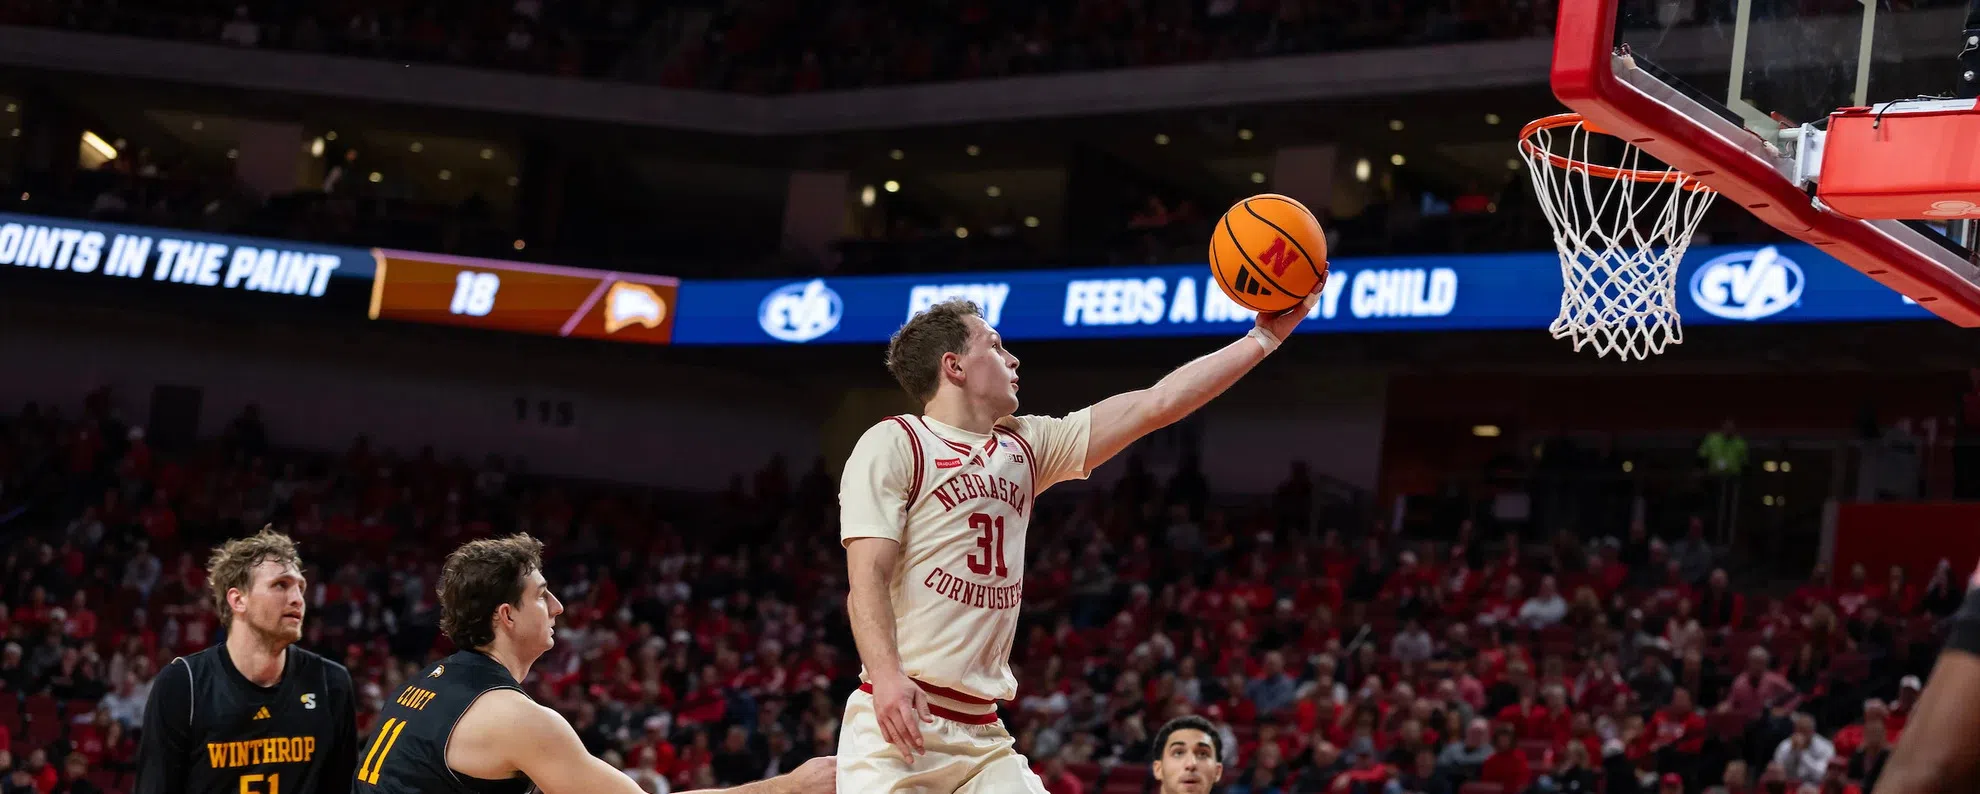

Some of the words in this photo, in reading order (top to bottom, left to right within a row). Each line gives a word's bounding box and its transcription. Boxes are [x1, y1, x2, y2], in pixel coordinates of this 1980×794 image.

[0, 222, 106, 273] OINTS
[103, 233, 153, 278] IN
[153, 238, 229, 287] THE
[223, 246, 341, 297] PAINT
[1257, 233, 1300, 278] N
[449, 270, 500, 316] 18
[1063, 276, 1167, 326] FEEDS
[1168, 276, 1198, 324] A
[1350, 267, 1458, 319] CHILD
[932, 473, 1025, 518] NEBRASKA
[966, 512, 1008, 579] 31
[207, 736, 316, 769] WINTHROP
[357, 717, 408, 786] 11
